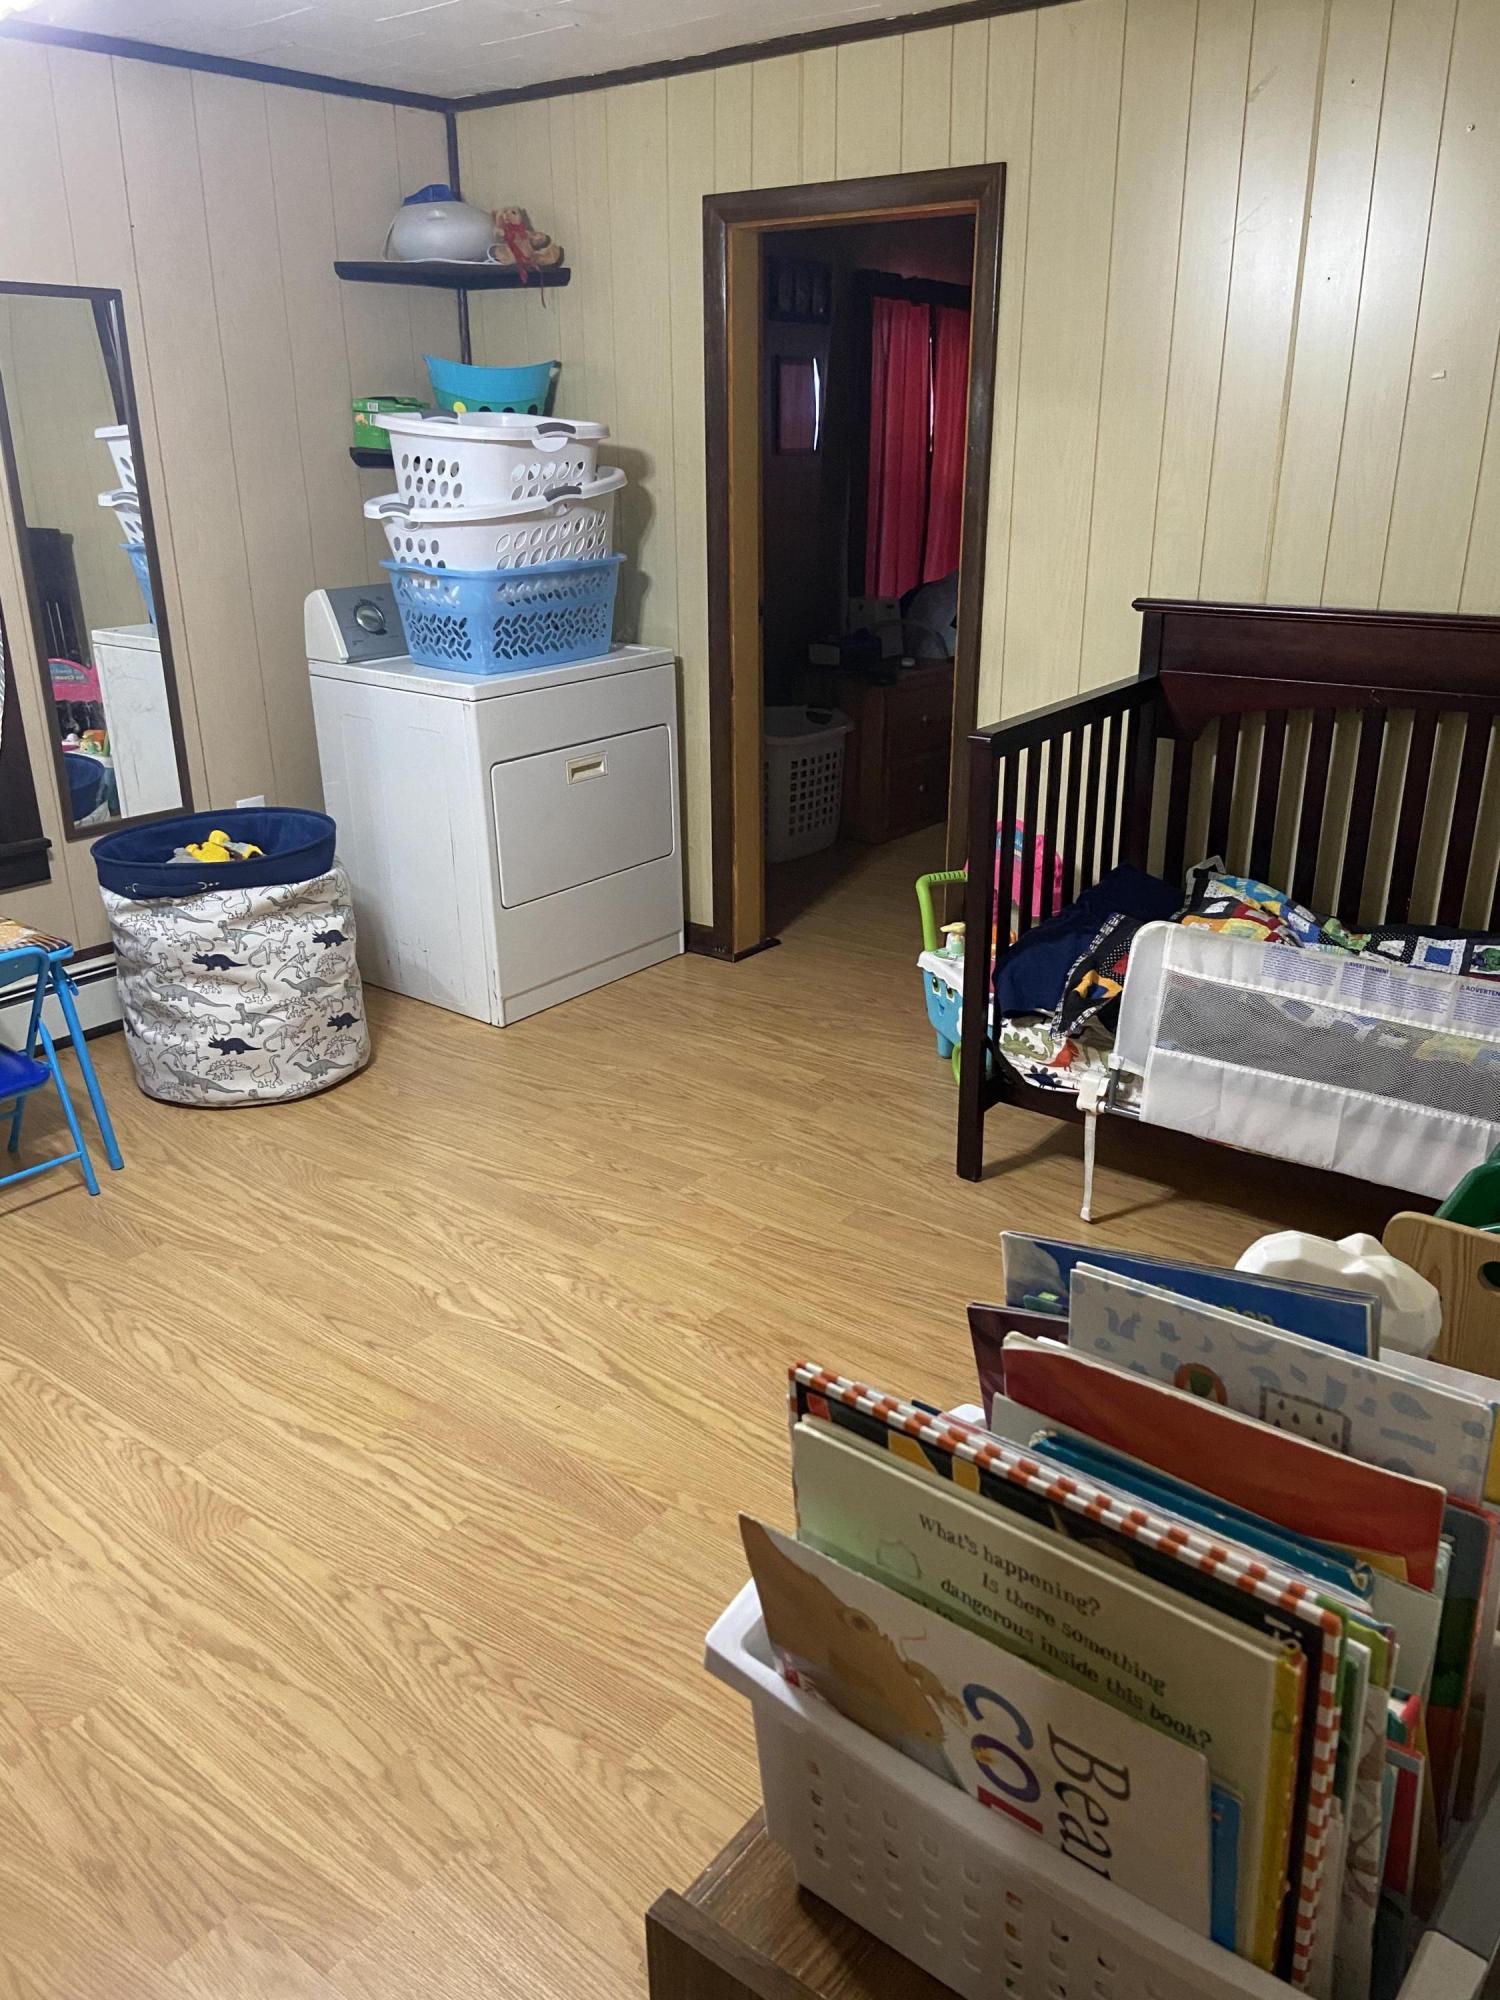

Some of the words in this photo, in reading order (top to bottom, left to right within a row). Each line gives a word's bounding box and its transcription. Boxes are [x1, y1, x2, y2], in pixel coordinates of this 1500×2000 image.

[919, 1513, 978, 1556] What's
[983, 1544, 1101, 1617] happening?
[941, 1579, 1034, 1644] dangerous
[1040, 1635, 1099, 1682] inside
[1106, 1677, 1144, 1710] this
[1150, 1701, 1213, 1749] book?
[981, 1572, 999, 1594] Is
[1005, 1587, 1056, 1628] there
[1061, 1622, 1167, 1698] something
